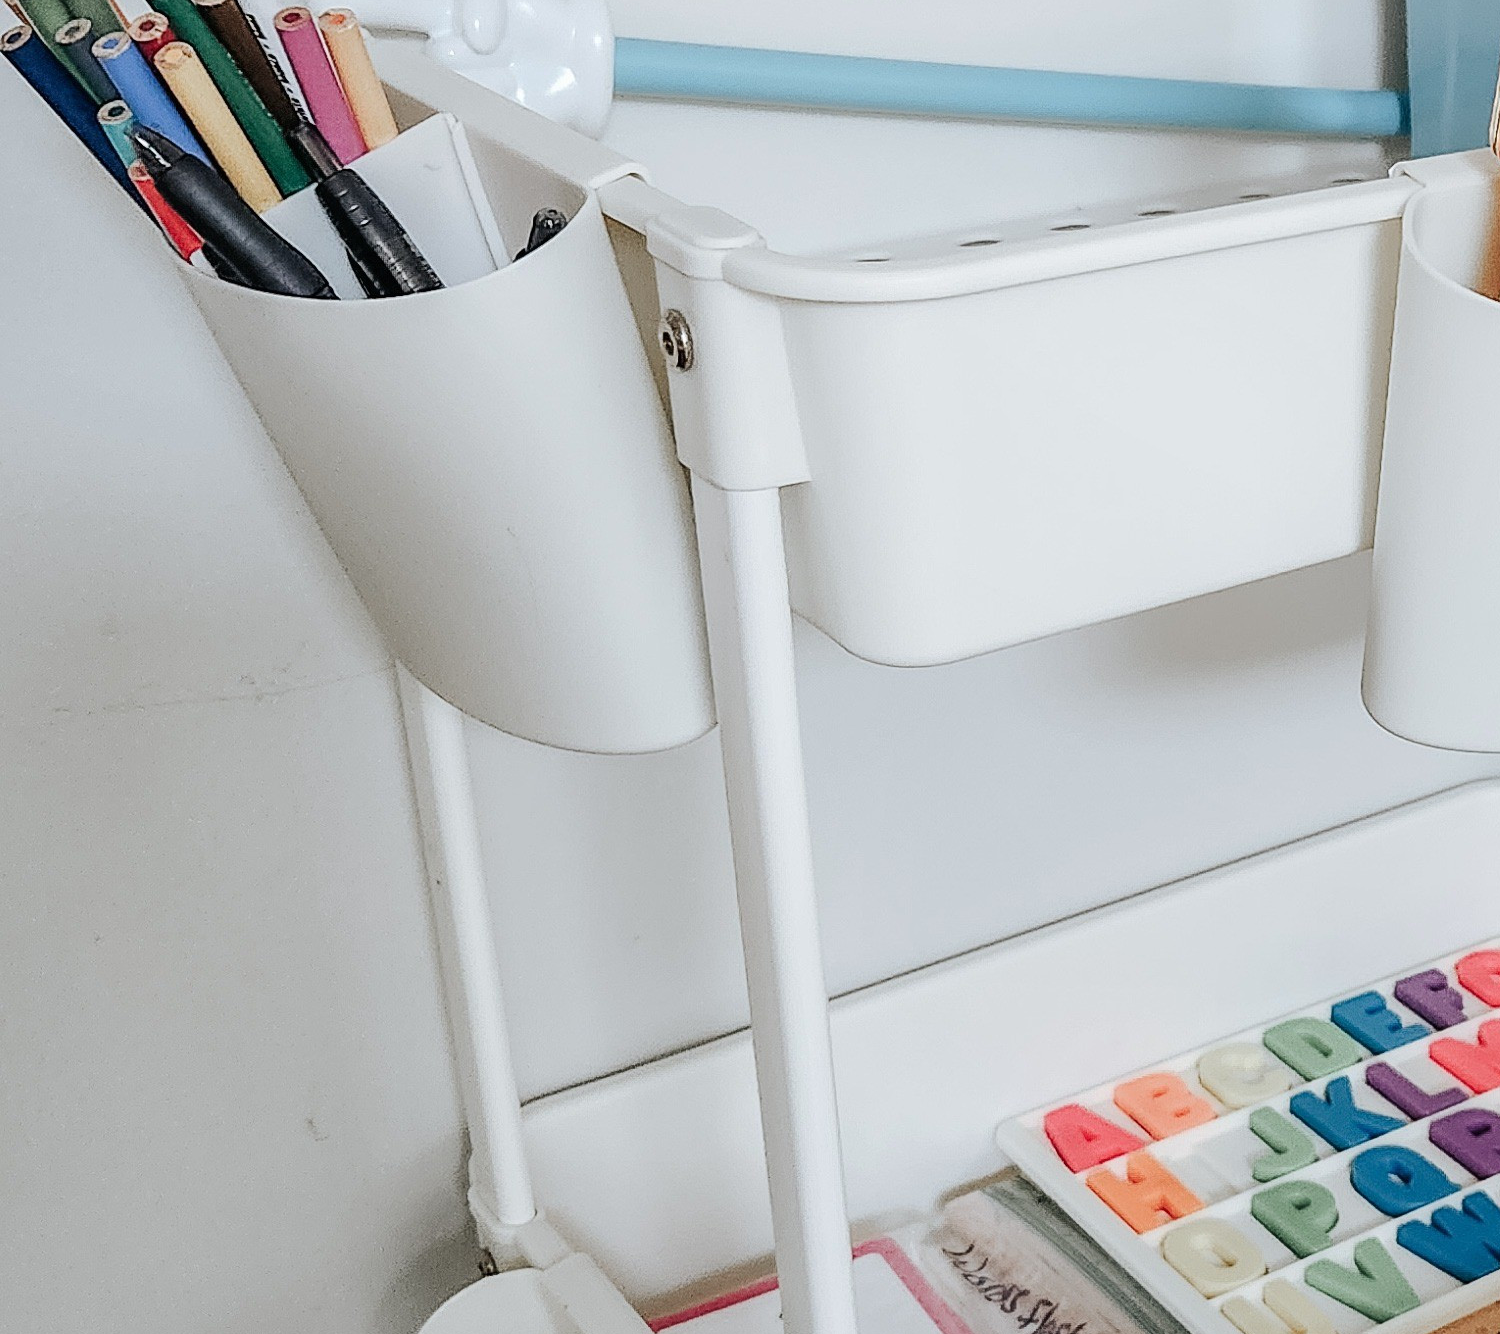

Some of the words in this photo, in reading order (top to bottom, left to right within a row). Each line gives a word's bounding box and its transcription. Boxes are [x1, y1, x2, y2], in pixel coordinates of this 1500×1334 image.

[1044, 1102, 1144, 1172] A
[1114, 1070, 1217, 1141] B
[1199, 1042, 1292, 1109] C
[1264, 1017, 1362, 1082] D
[1331, 991, 1432, 1054] E
[1395, 968, 1468, 1030] F
[1086, 1151, 1204, 1233] H
[1252, 1107, 1318, 1182] J
[1290, 1075, 1406, 1153] K
[1366, 1061, 1470, 1121] L
[1162, 1218, 1267, 1299] O
[1252, 1181, 1339, 1259] P
[1350, 1146, 1462, 1218] Q
[1306, 1236, 1420, 1323] V
